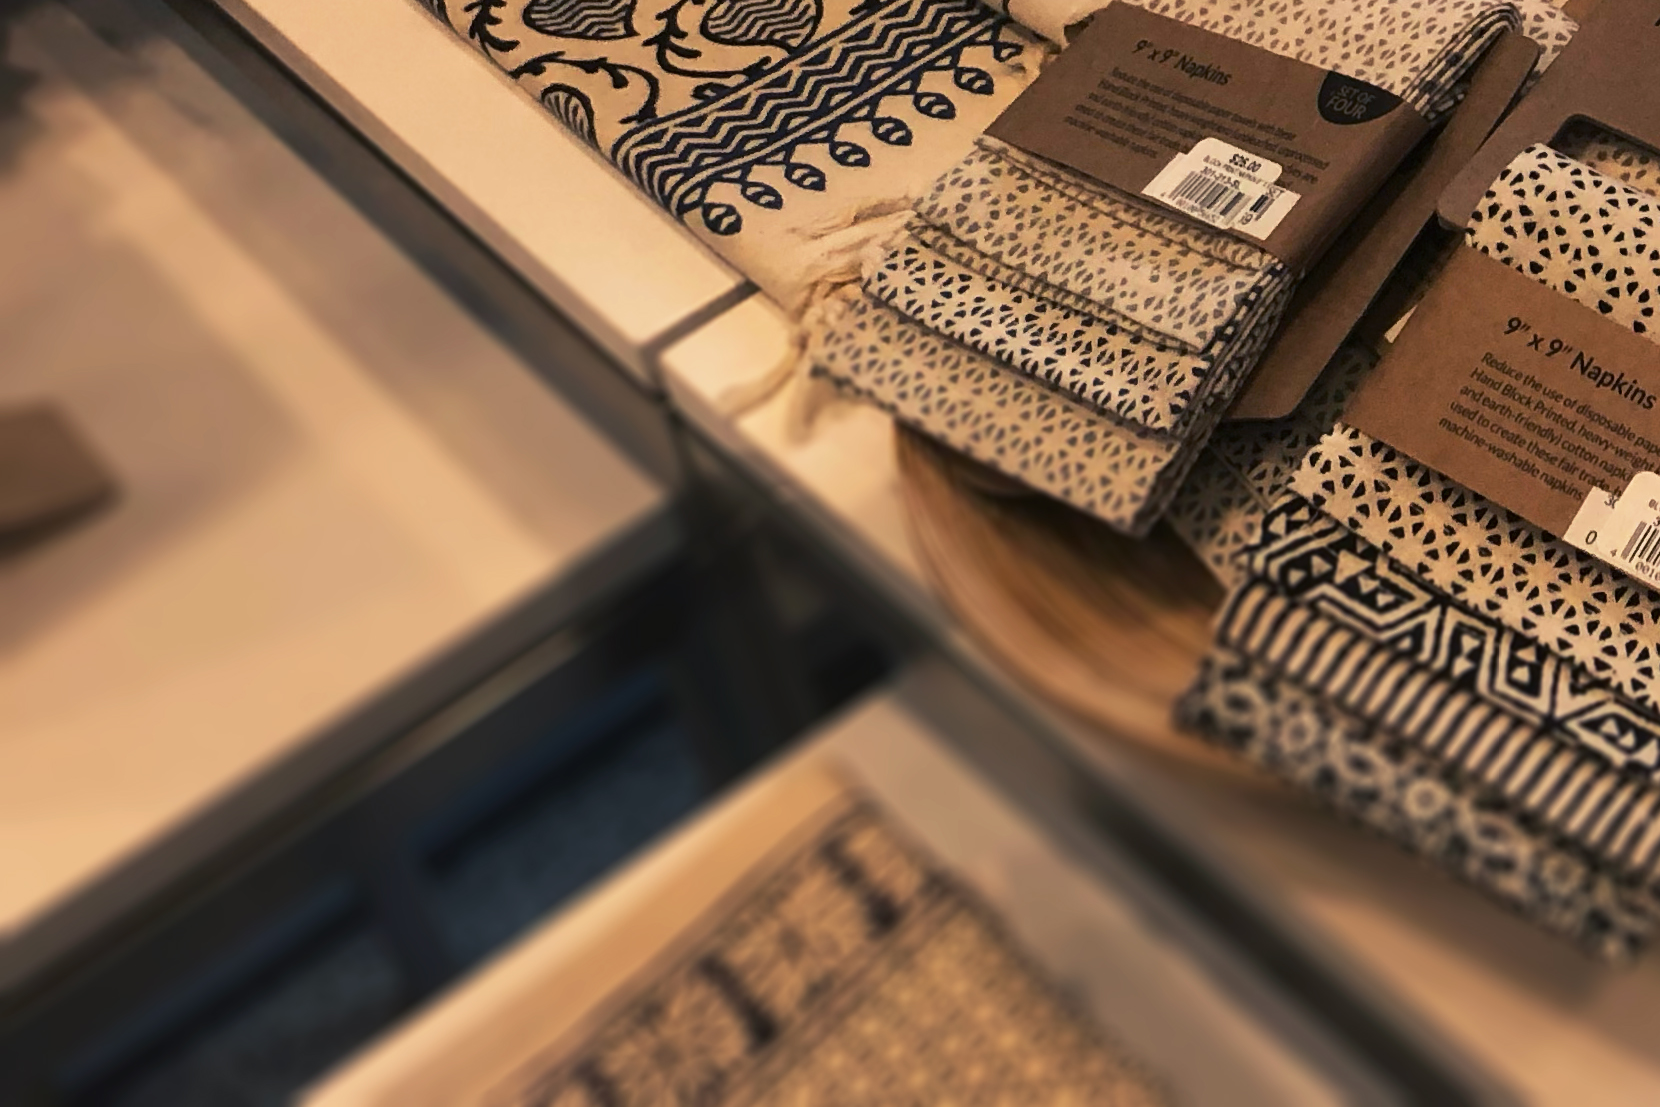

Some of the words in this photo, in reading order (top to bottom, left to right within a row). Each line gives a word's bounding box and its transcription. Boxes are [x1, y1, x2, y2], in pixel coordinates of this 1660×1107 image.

[1173, 54, 1232, 86] Napkins
[1325, 95, 1367, 119] FOUR
[1481, 351, 1524, 381] Reduce
[1523, 373, 1543, 393] the
[1543, 387, 1563, 404] use
[1563, 396, 1578, 410] of
[1576, 404, 1636, 441] disposable
[1526, 333, 1544, 351] x
[1569, 351, 1657, 410] Napkins
[1439, 417, 1540, 478] machine-washable
[1449, 400, 1478, 421] used
[1477, 413, 1490, 428] to
[1489, 420, 1528, 448] create
[1527, 440, 1559, 464] these
[1557, 457, 1580, 474] fair
[1459, 384, 1482, 404] and
[1481, 394, 1563, 446] earth-friendly)
[1561, 438, 1600, 465] cotton
[1470, 367, 1504, 391] Hand
[1502, 381, 1535, 409] Block
[1576, 424, 1655, 471] heavy-weight
